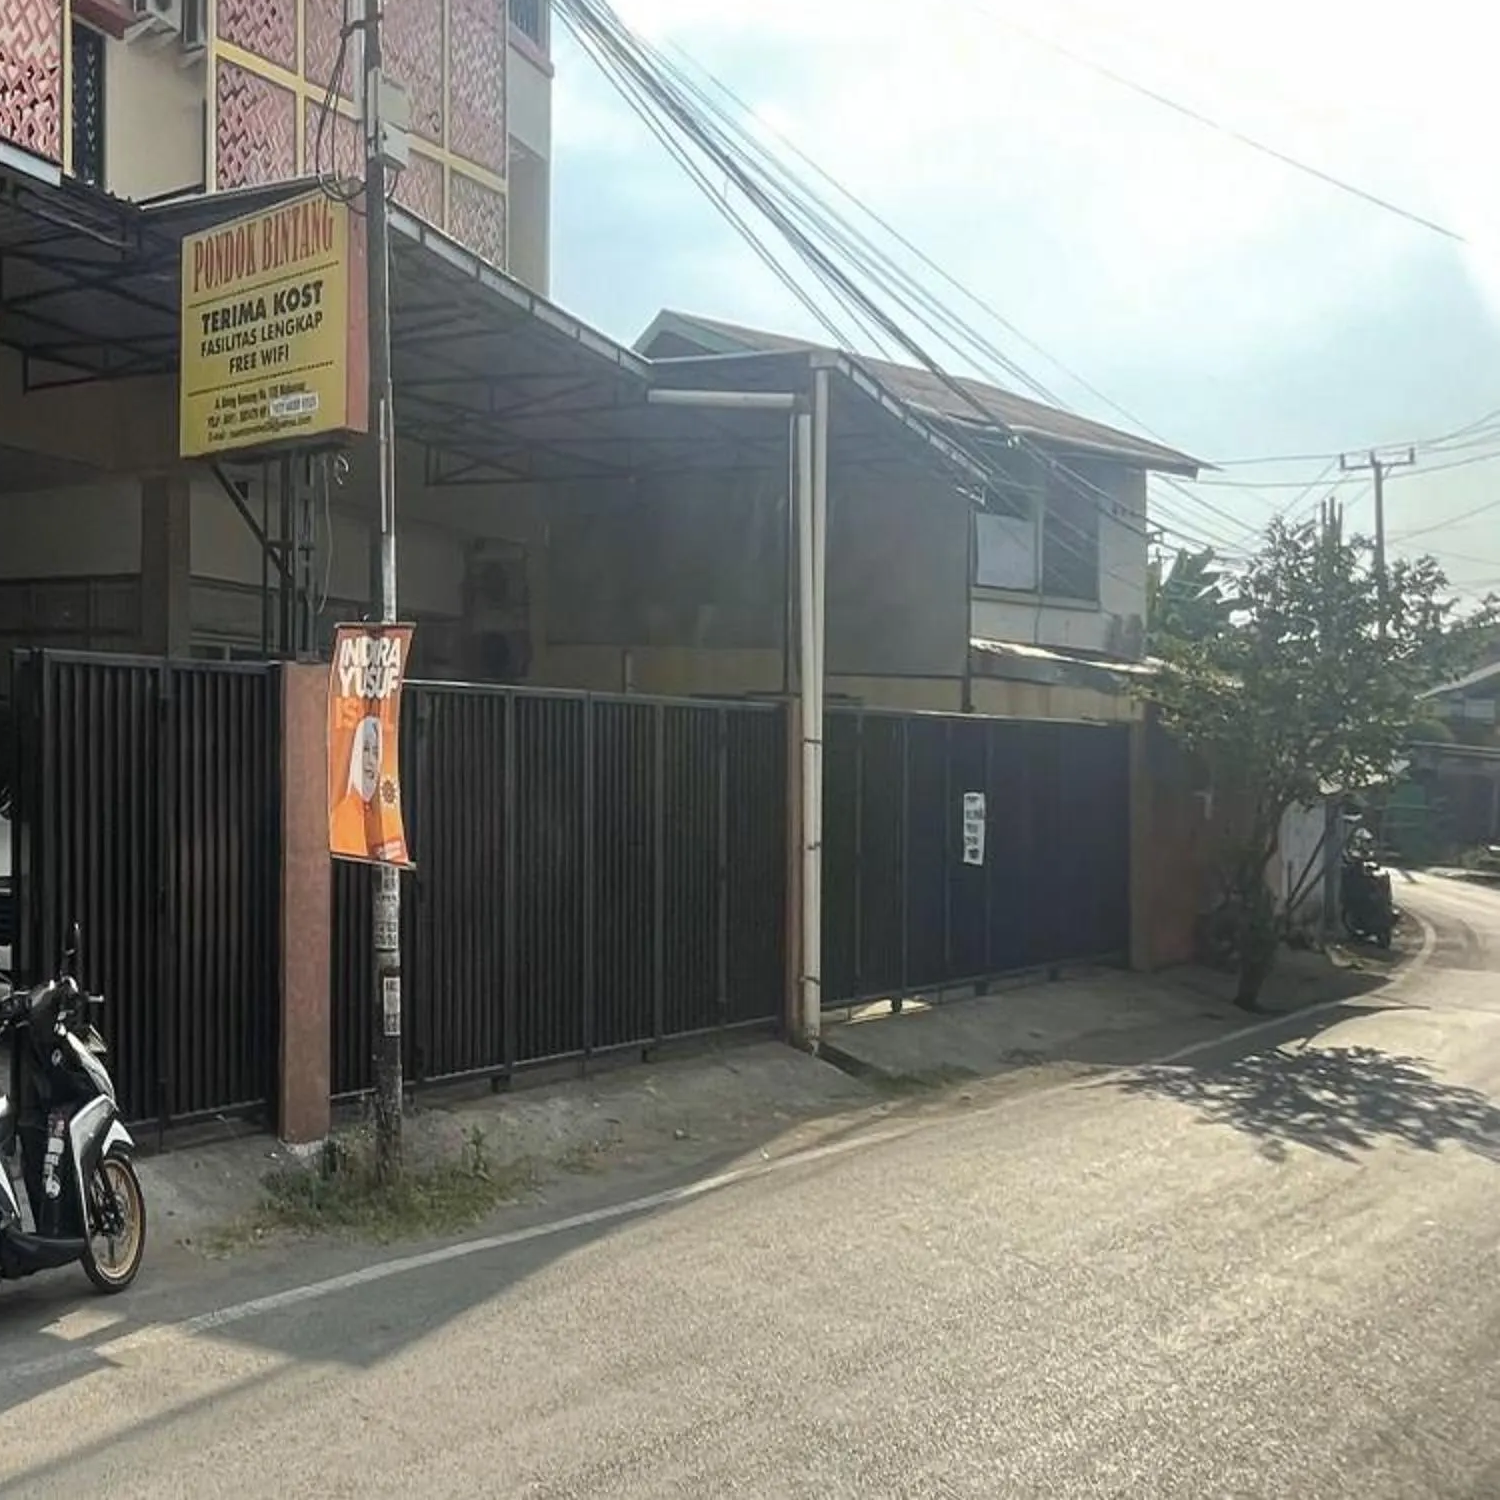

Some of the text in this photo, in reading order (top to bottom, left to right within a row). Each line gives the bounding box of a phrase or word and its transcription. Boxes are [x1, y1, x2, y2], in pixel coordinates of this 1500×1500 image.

[193, 197, 335, 293] PONDOK BINTANG
[201, 280, 323, 335] TERIMA KOST
[201, 311, 323, 357] FASILITAS LENGKAP
[229, 344, 289, 376] FREE WIFI
[339, 666, 399, 699] YUSUF
